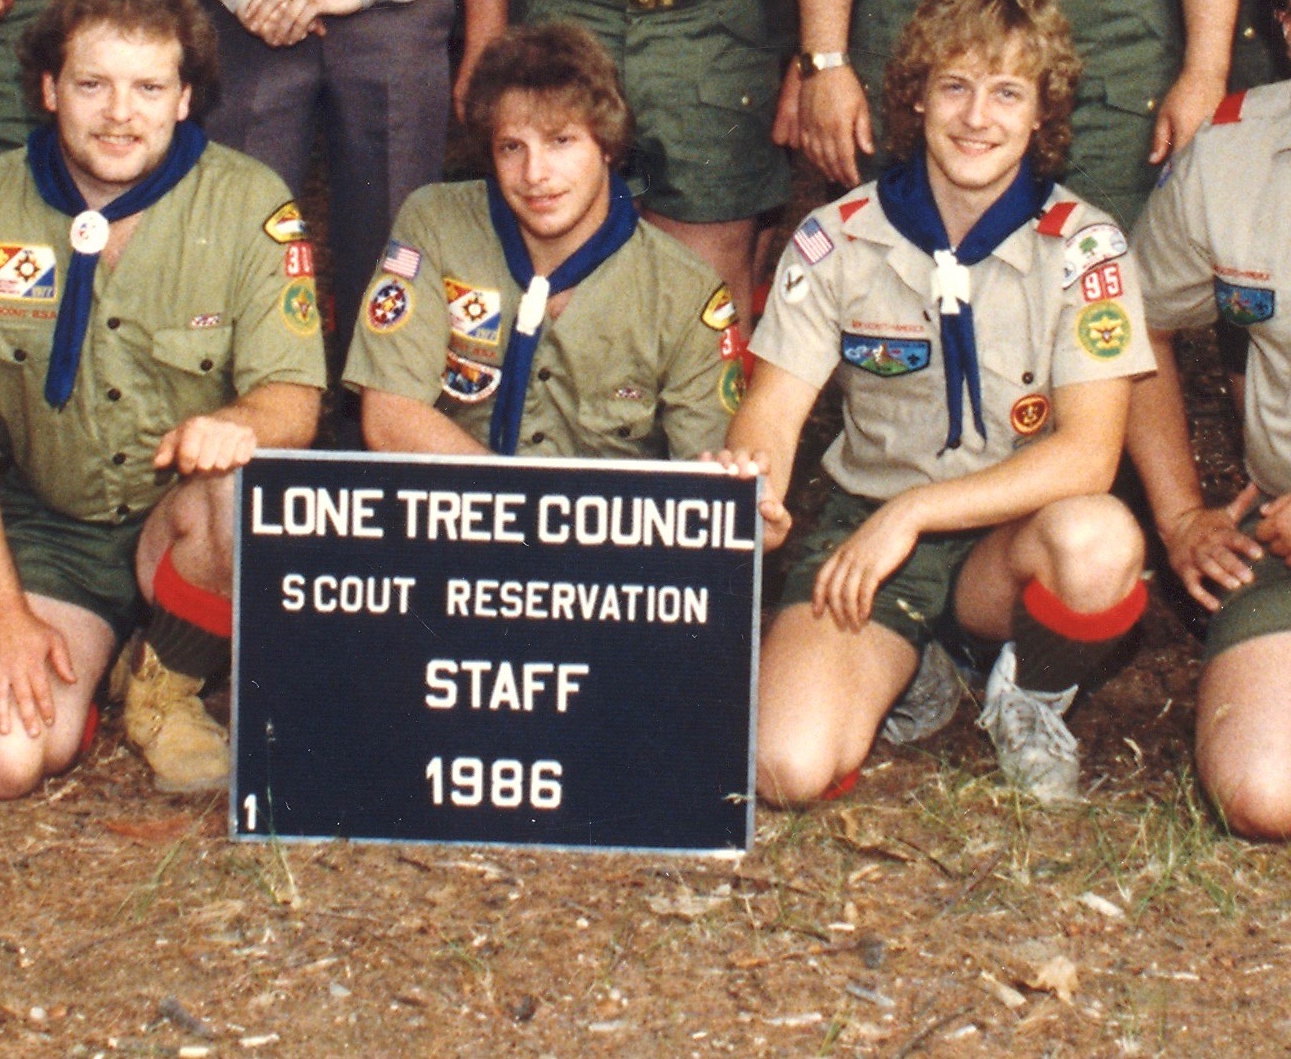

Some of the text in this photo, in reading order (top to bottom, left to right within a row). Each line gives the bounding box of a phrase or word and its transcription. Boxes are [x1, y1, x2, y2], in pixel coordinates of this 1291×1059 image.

[288, 245, 311, 274] 31
[1085, 266, 1120, 300] 95
[251, 486, 756, 550] LONE TREE COUNCIL
[281, 573, 708, 624] SCOUT RESERVATION
[425, 658, 590, 712] STAFF
[425, 756, 563, 809] 1986
[242, 793, 257, 831] 1
